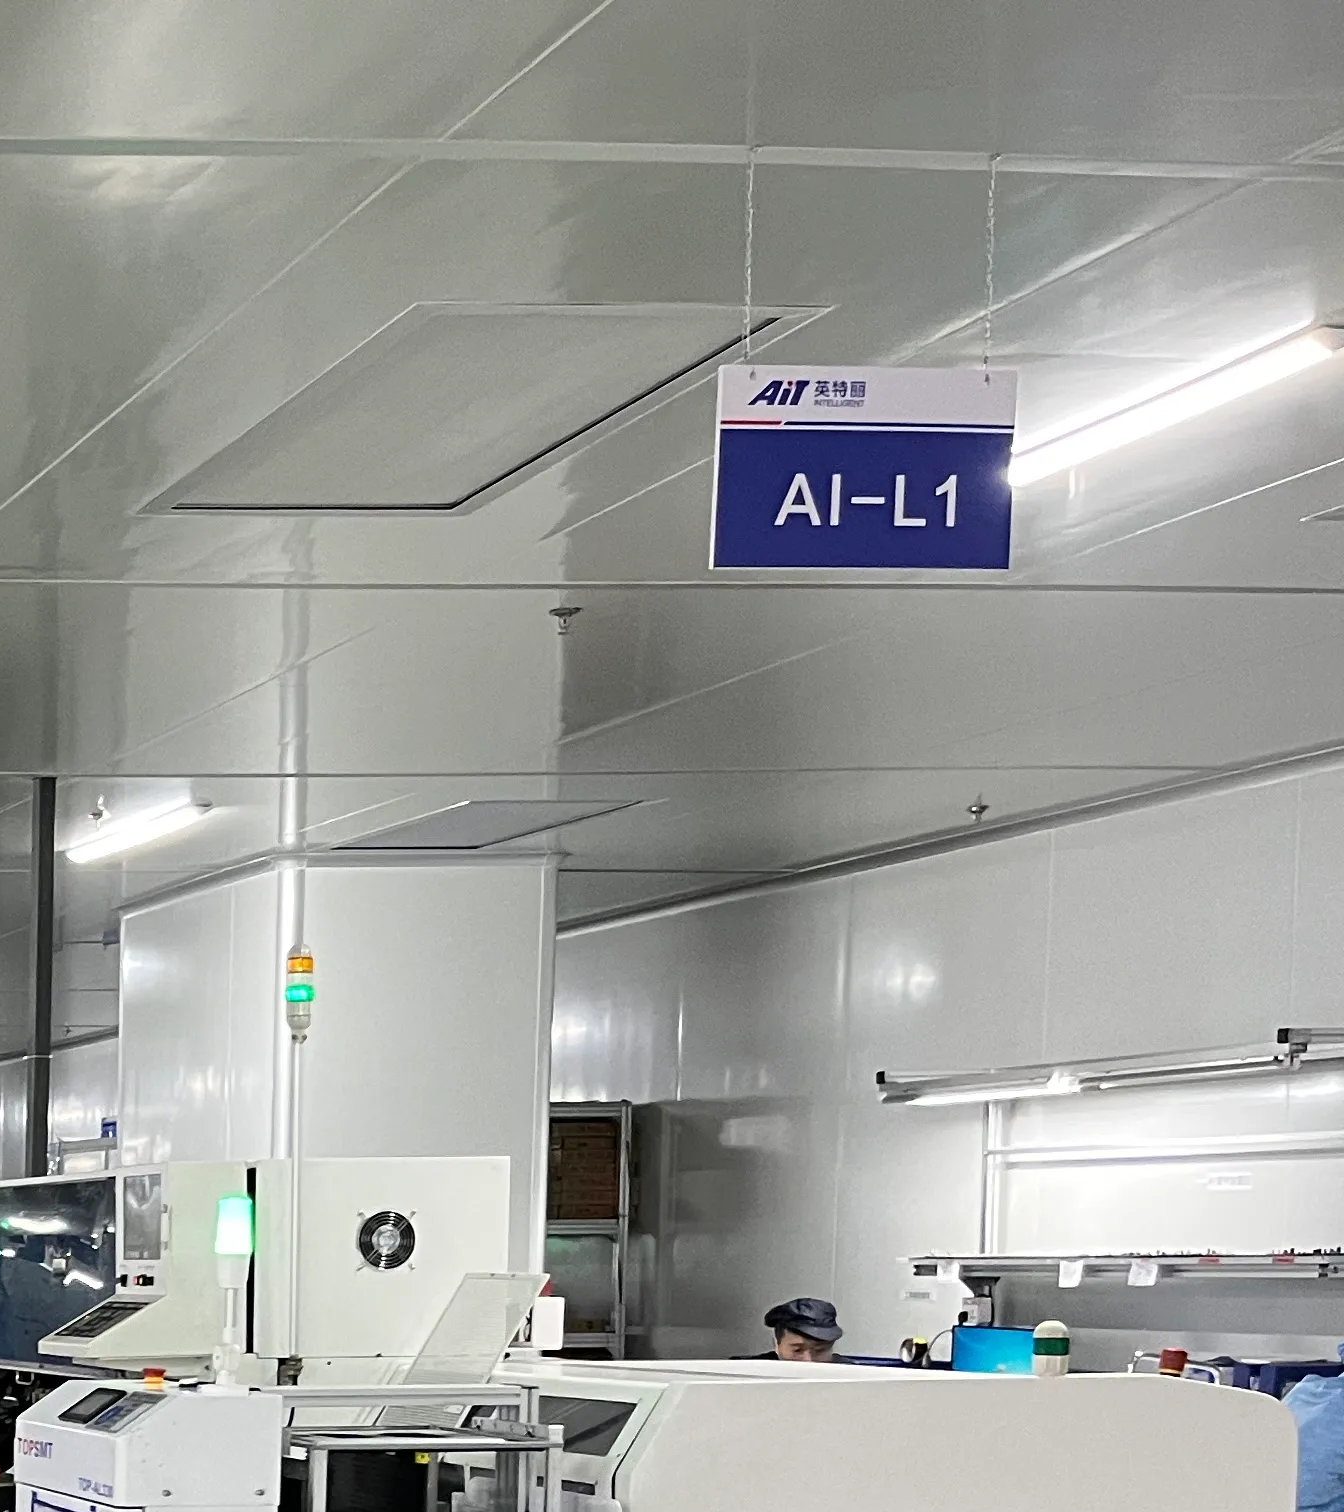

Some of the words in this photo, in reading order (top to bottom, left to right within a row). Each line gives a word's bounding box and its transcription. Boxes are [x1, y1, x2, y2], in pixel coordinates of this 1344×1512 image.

[814, 381, 867, 398] 英特丽
[774, 473, 958, 527] AI-L1
[17, 1437, 54, 1459] TOPSMT
